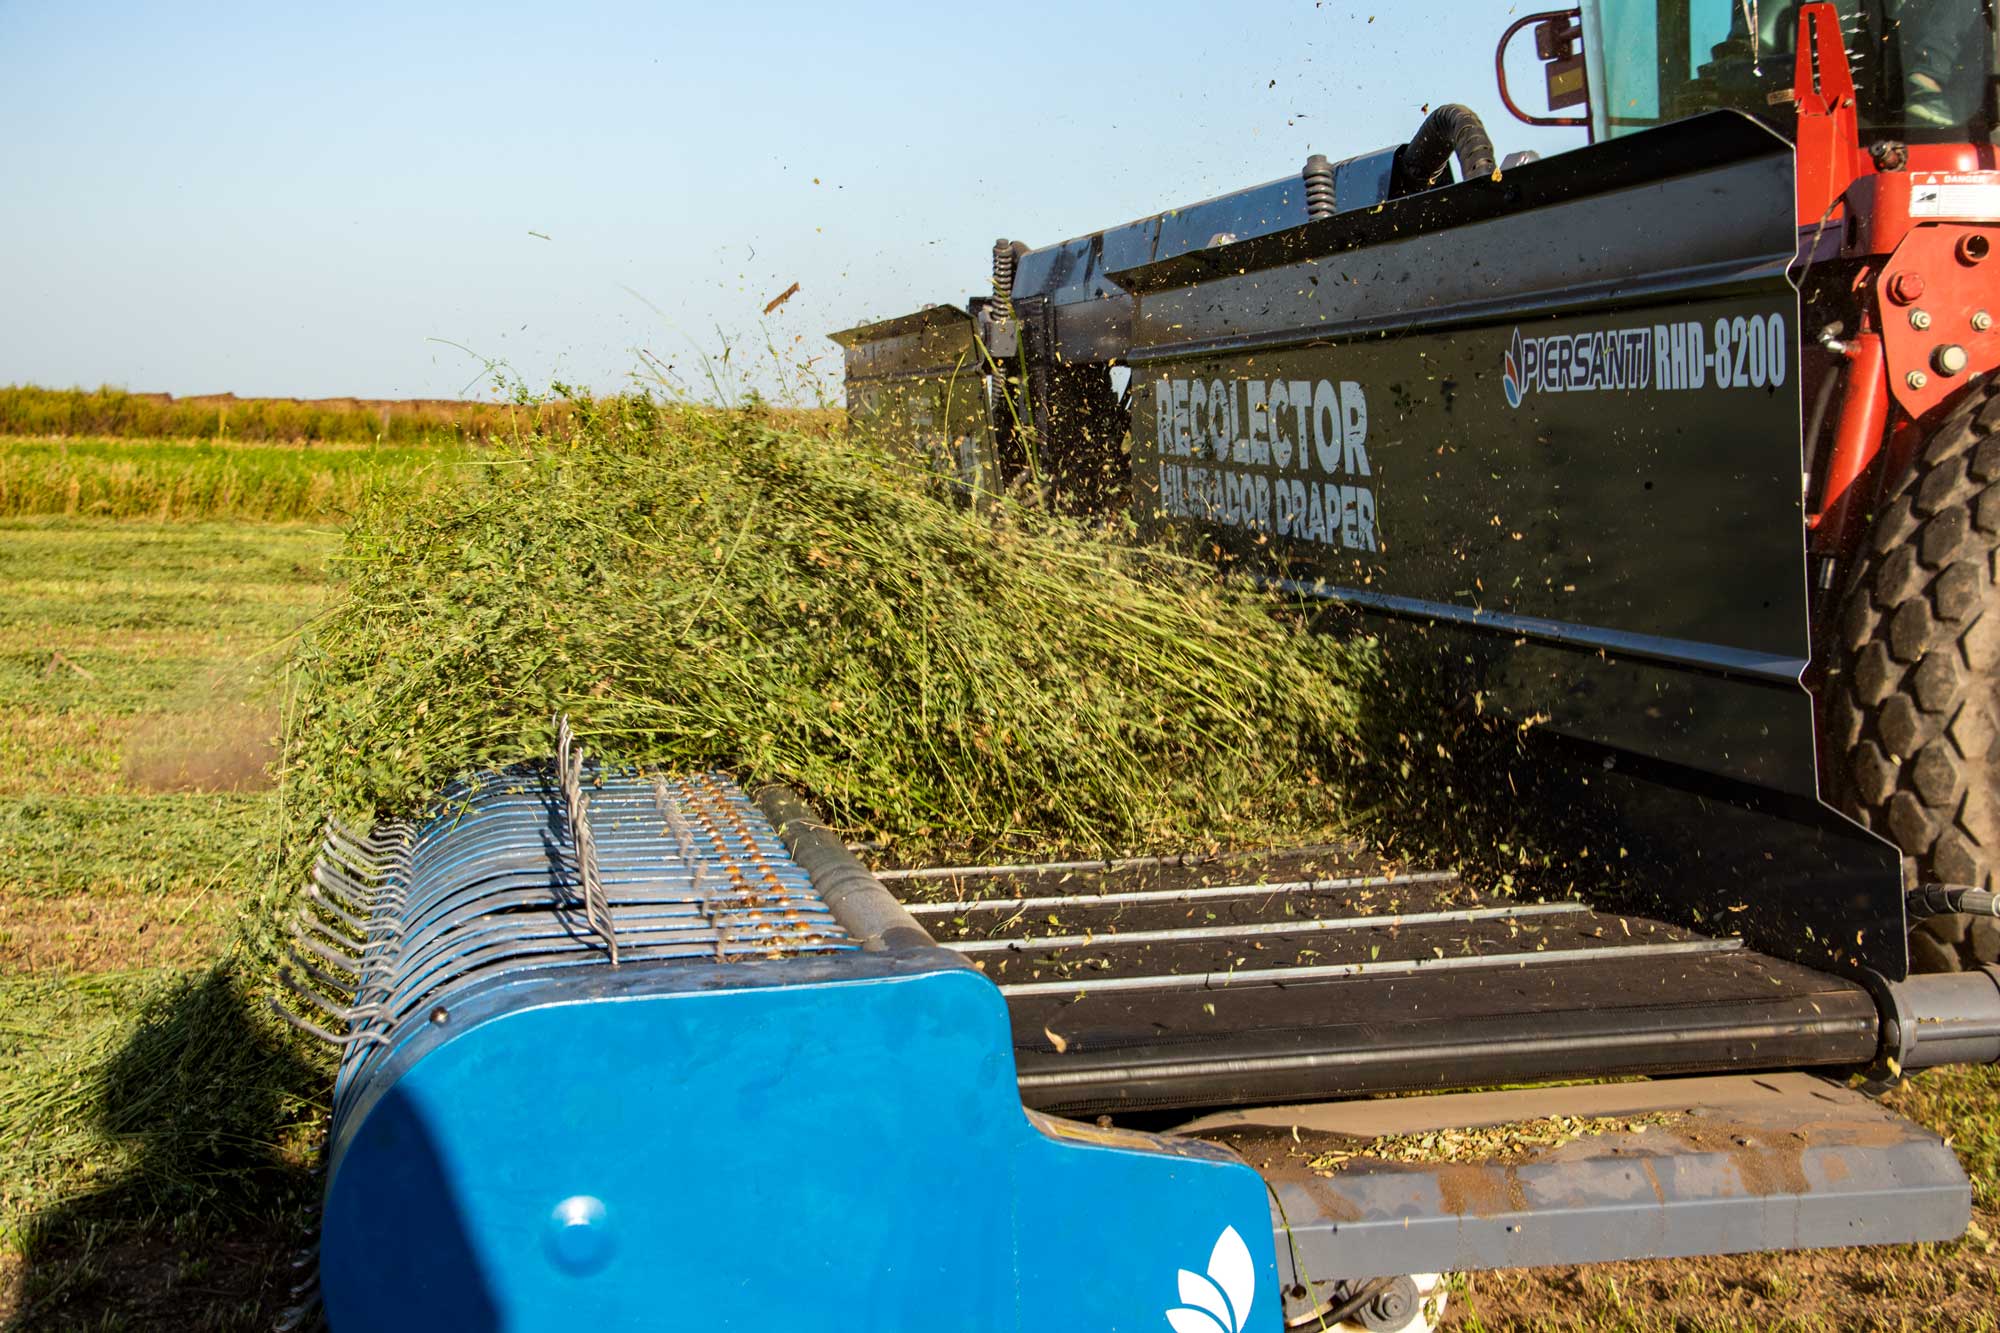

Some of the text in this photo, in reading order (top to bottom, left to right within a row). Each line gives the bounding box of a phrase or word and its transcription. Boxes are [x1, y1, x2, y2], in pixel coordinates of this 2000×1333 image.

[1522, 312, 1786, 394] PIERSANTI RHD-8200
[1156, 378, 1371, 476] RECOLECTOR
[1275, 478, 1376, 553] DRAPER
